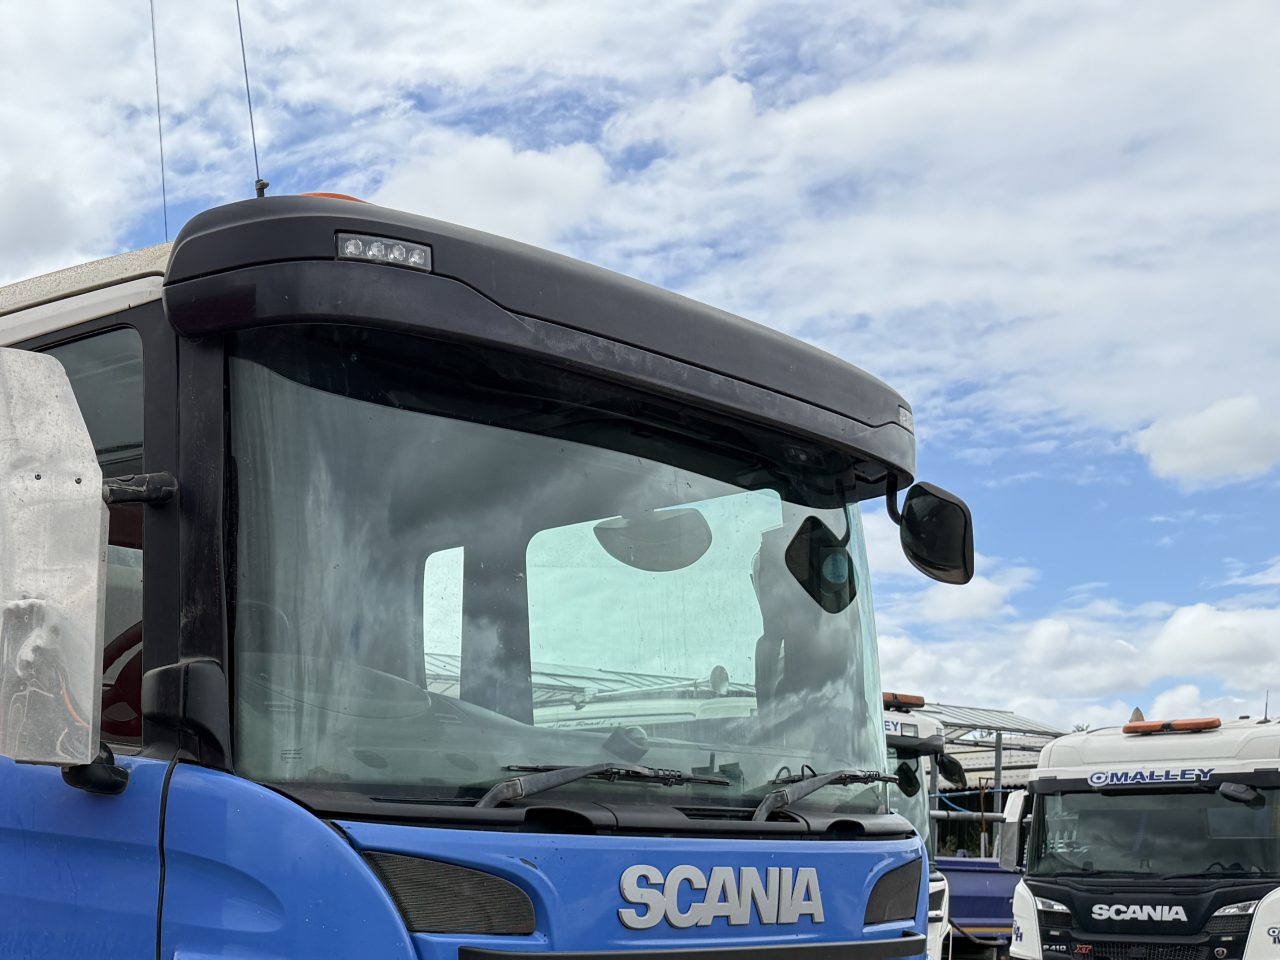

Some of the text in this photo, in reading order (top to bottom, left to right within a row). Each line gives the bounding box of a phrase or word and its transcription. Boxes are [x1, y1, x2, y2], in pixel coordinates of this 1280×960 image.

[617, 864, 825, 930] SCANIA
[1091, 904, 1188, 921] SCANIA
[1051, 944, 1067, 952] 410
